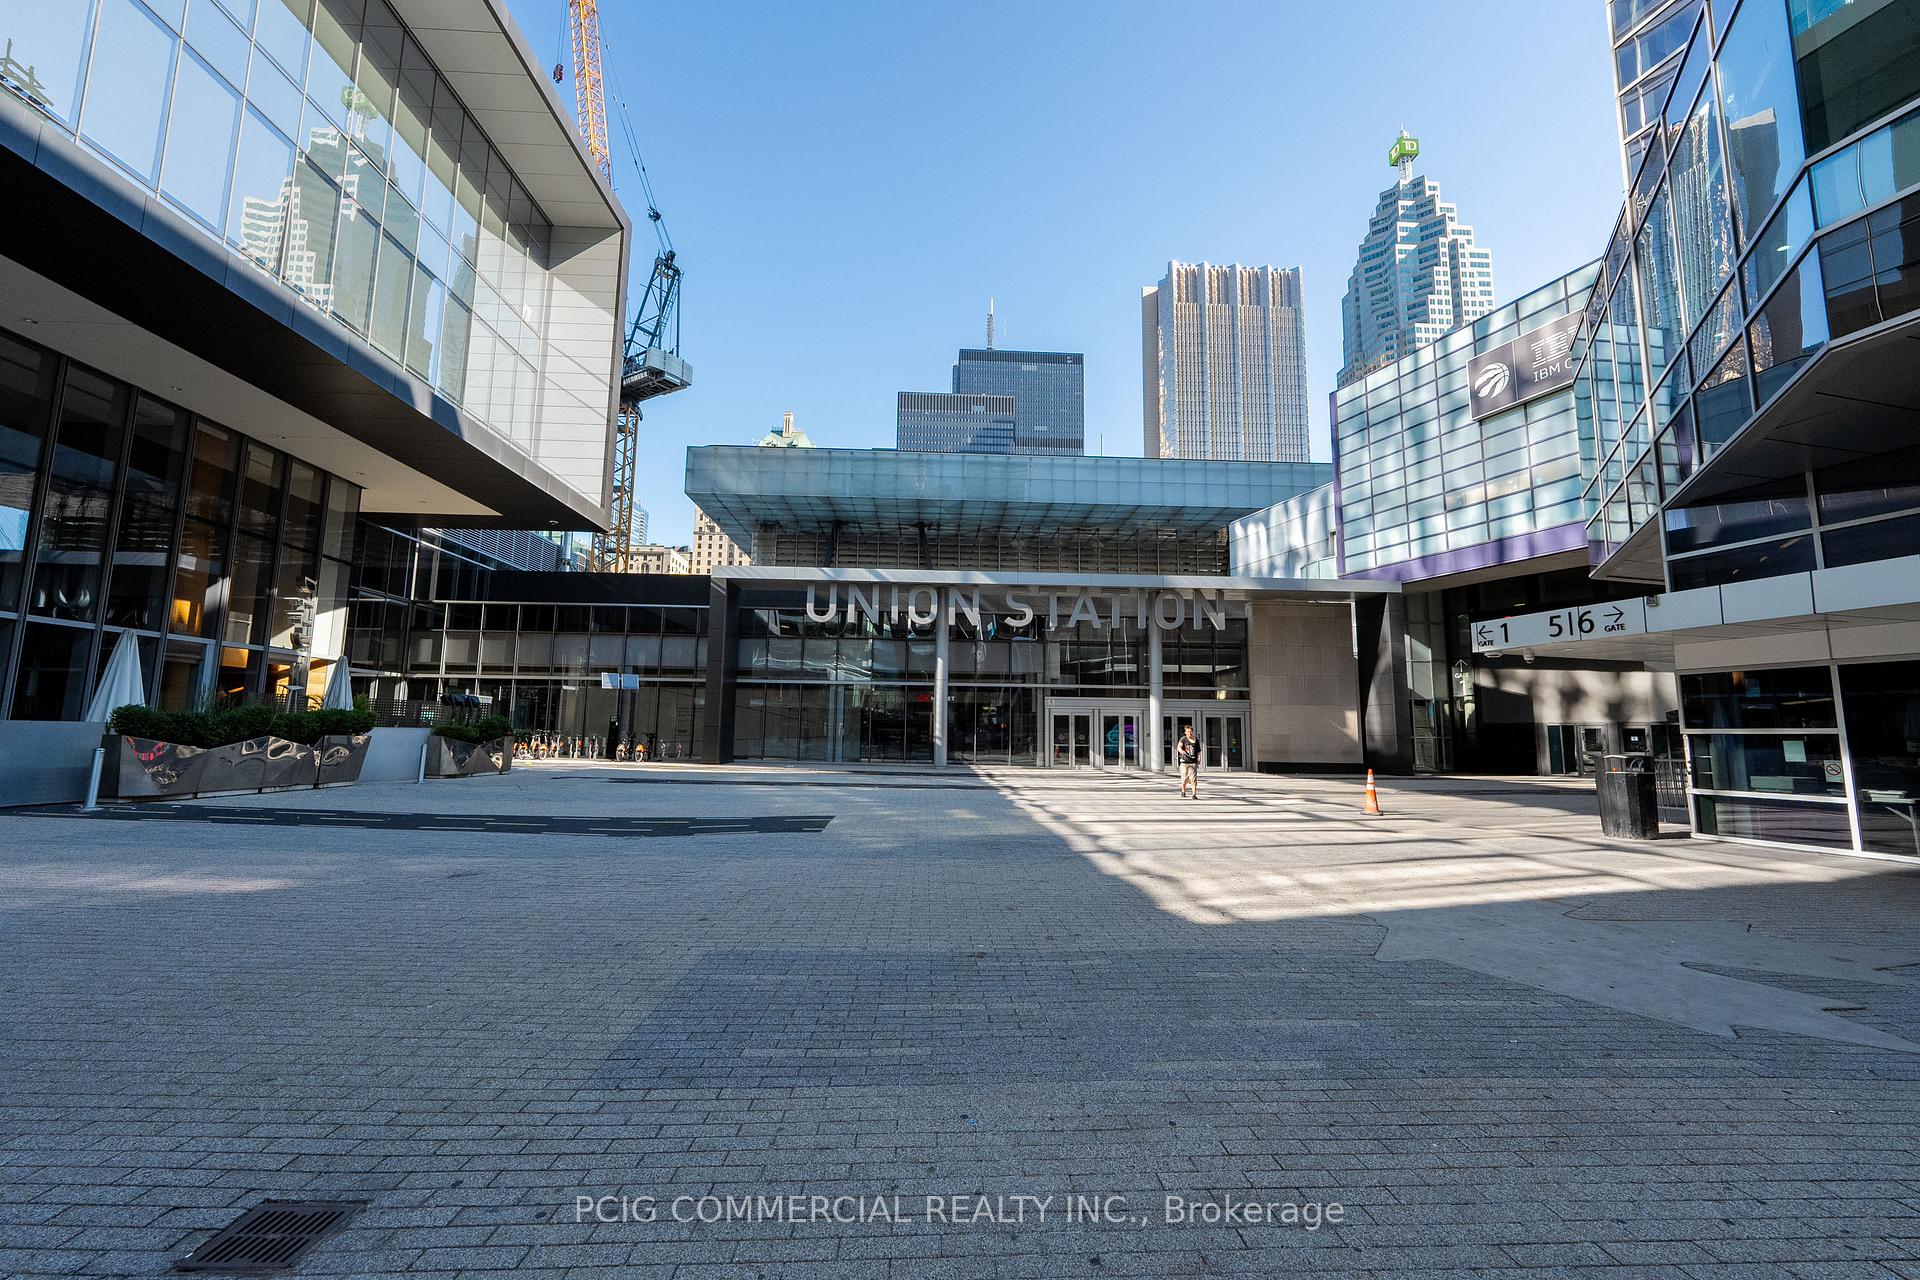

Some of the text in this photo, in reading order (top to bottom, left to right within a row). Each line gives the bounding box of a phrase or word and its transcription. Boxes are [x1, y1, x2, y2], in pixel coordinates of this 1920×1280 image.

[1402, 140, 1417, 151] TD
[1531, 325, 1577, 369] IB
[1533, 363, 1561, 383] IBM
[806, 583, 1226, 631] UNION STATION
[1478, 622, 1509, 648] GATE 1
[1604, 623, 1626, 632] GATE
